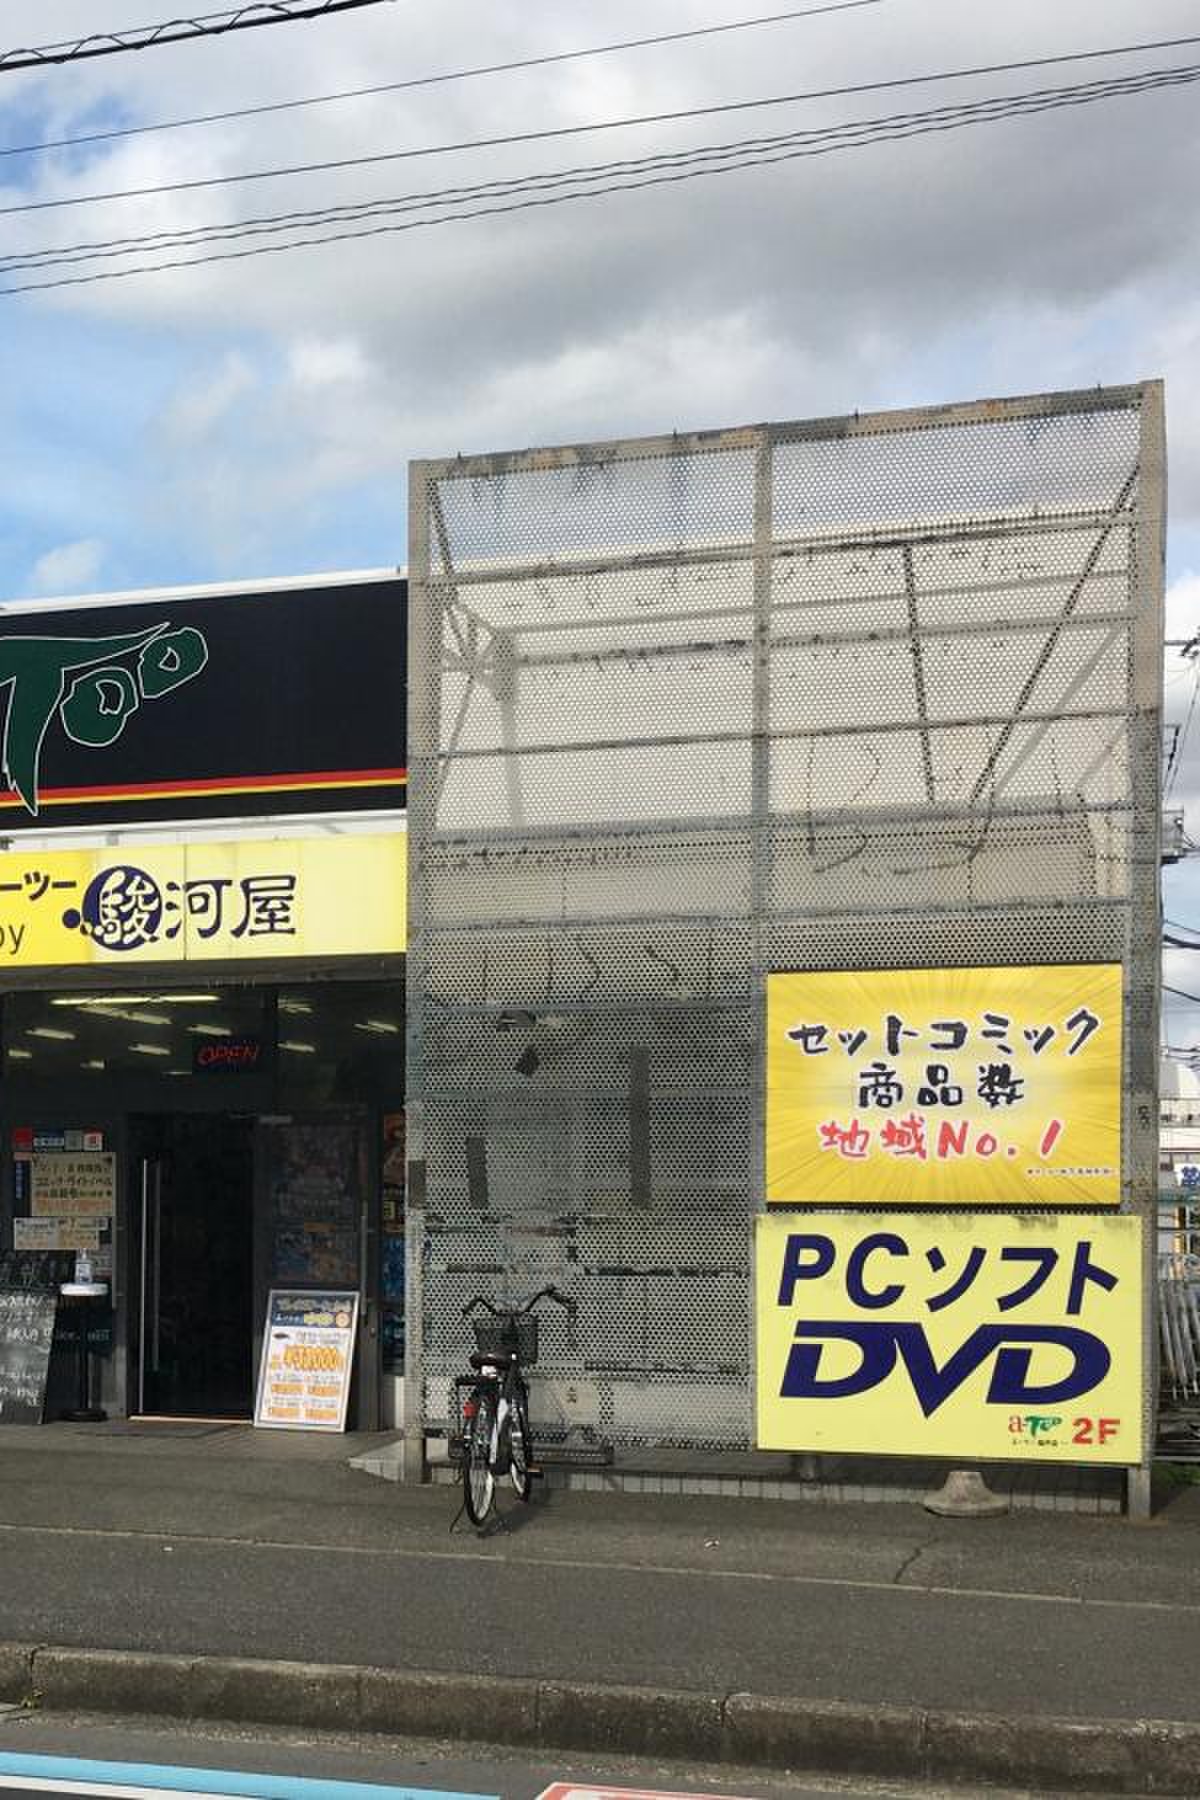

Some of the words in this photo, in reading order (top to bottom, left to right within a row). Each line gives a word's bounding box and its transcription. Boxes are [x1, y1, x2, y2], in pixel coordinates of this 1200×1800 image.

[80, 867, 297, 948] 駿河屋
[788, 1009, 1100, 1056] セットコミック
[858, 1063, 1025, 1109] 商品数
[820, 1113, 1063, 1160] 地域No.1
[777, 1232, 1120, 1316] PCソフト
[779, 1319, 1112, 1419] DVD
[1072, 1417, 1121, 1445] 2F
